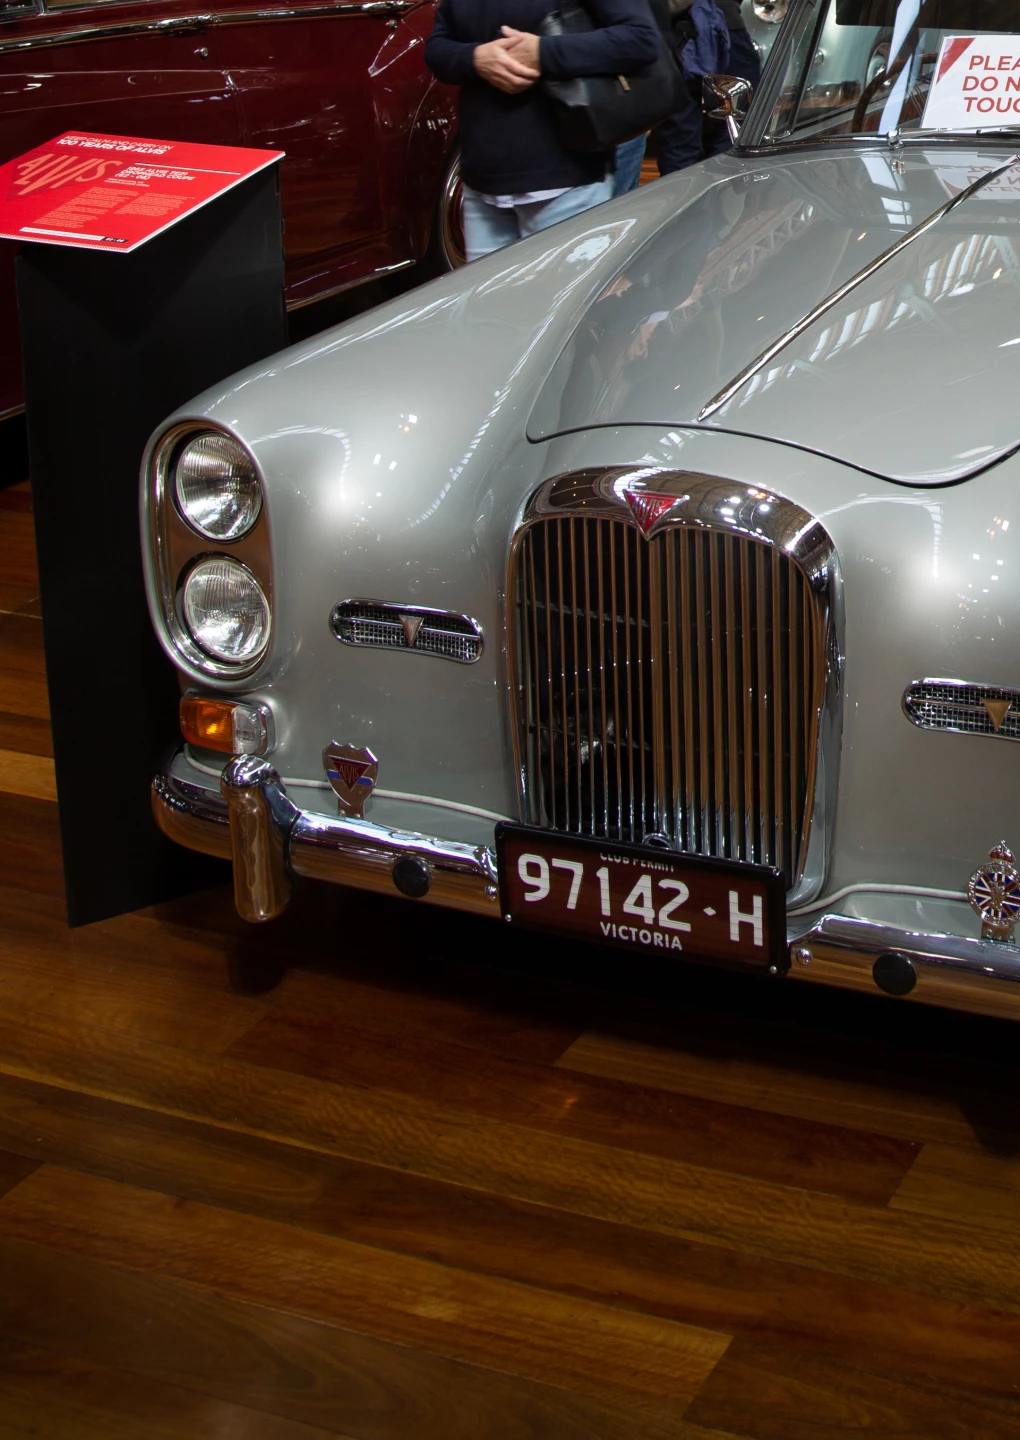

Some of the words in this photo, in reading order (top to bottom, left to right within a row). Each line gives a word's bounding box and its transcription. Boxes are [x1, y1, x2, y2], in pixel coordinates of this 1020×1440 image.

[962, 76, 999, 92] DO
[56, 138, 78, 146] 100
[78, 140, 117, 150] YEARS
[131, 146, 168, 155] ALVIS
[14, 154, 123, 195] ALVIS
[340, 764, 359, 784] ALVIS
[600, 921, 683, 951] VICTORIA
